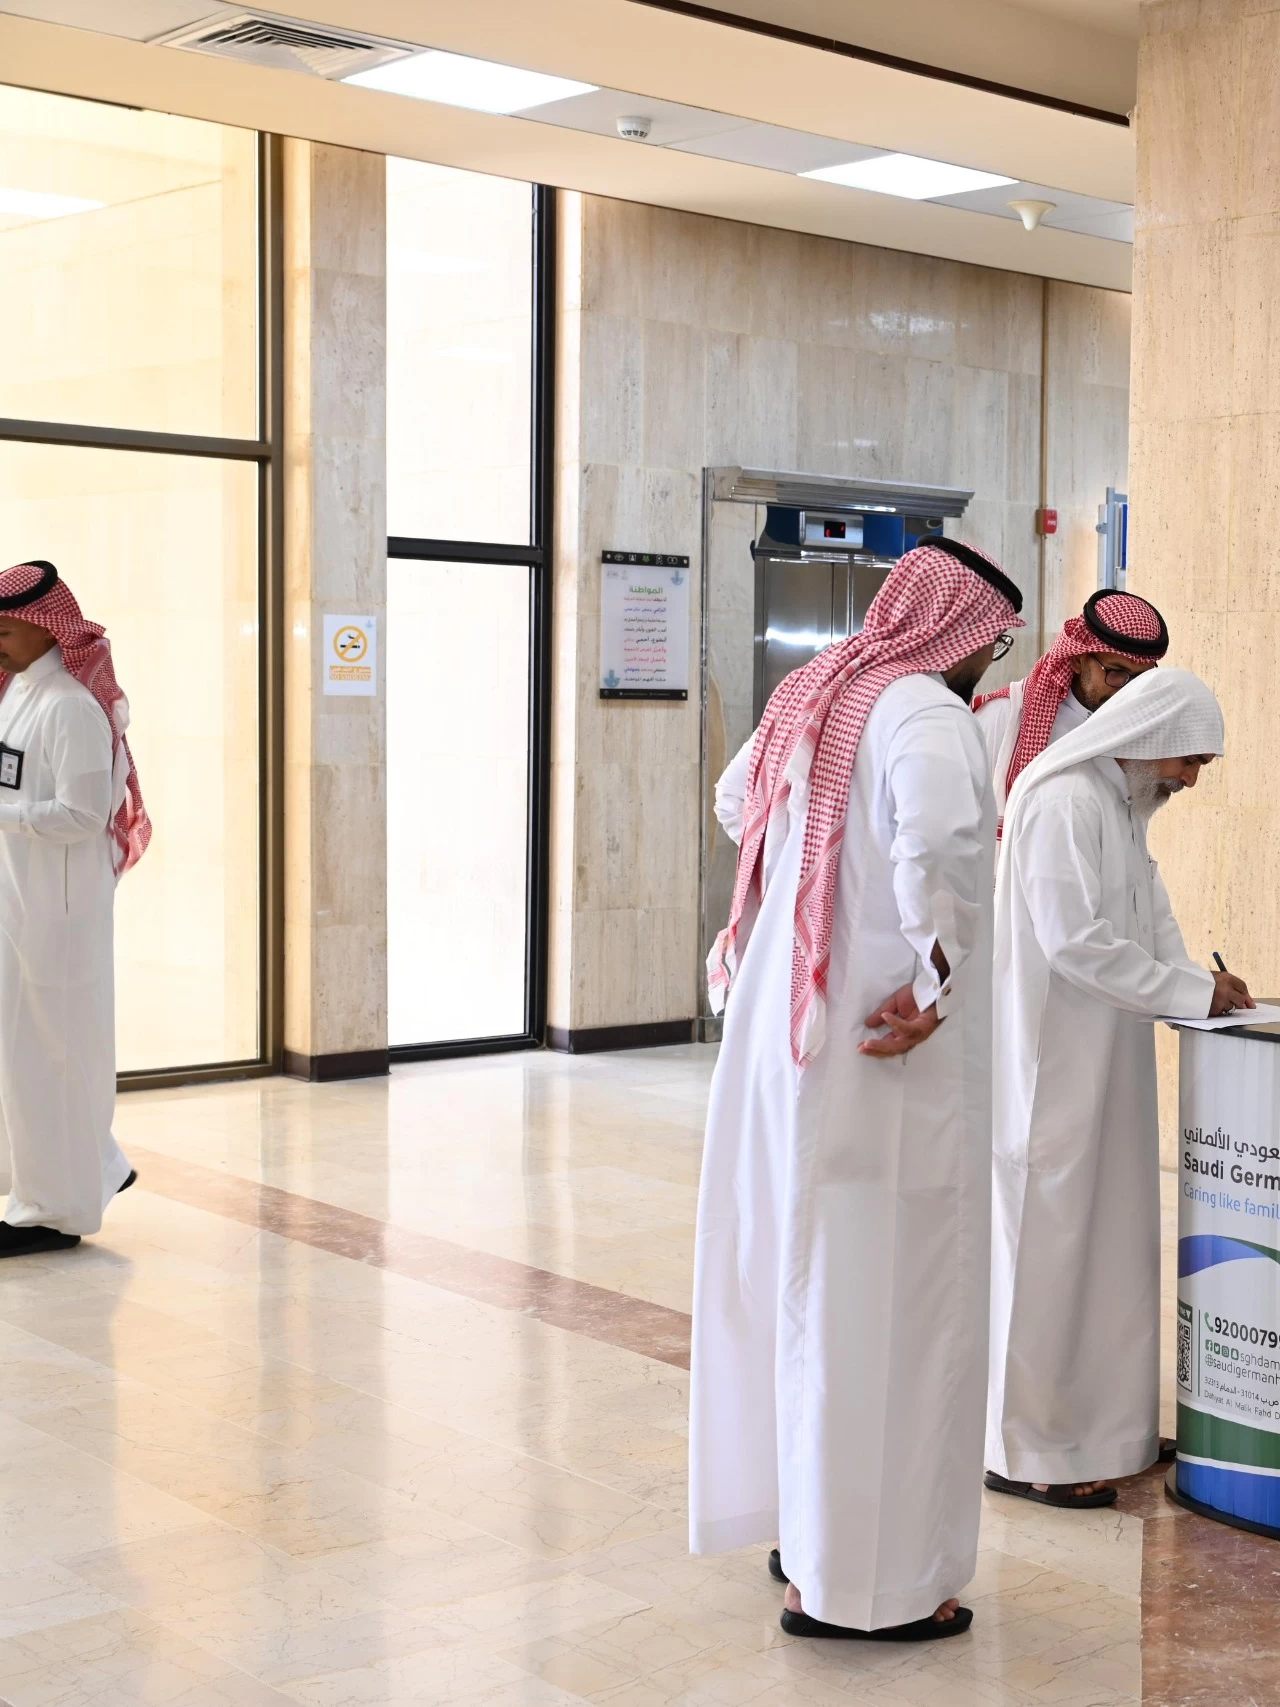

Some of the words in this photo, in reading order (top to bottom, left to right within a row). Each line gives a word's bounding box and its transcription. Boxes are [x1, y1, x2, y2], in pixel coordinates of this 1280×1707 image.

[629, 586, 664, 595] المواطنة
[1184, 1126, 1230, 1150] الألماني
[1184, 1152, 1224, 1180] Saudi
[1184, 1182, 1216, 1208] Caring
[1219, 1192, 1241, 1212] like
[1254, 1407, 1272, 1418] Fahd
